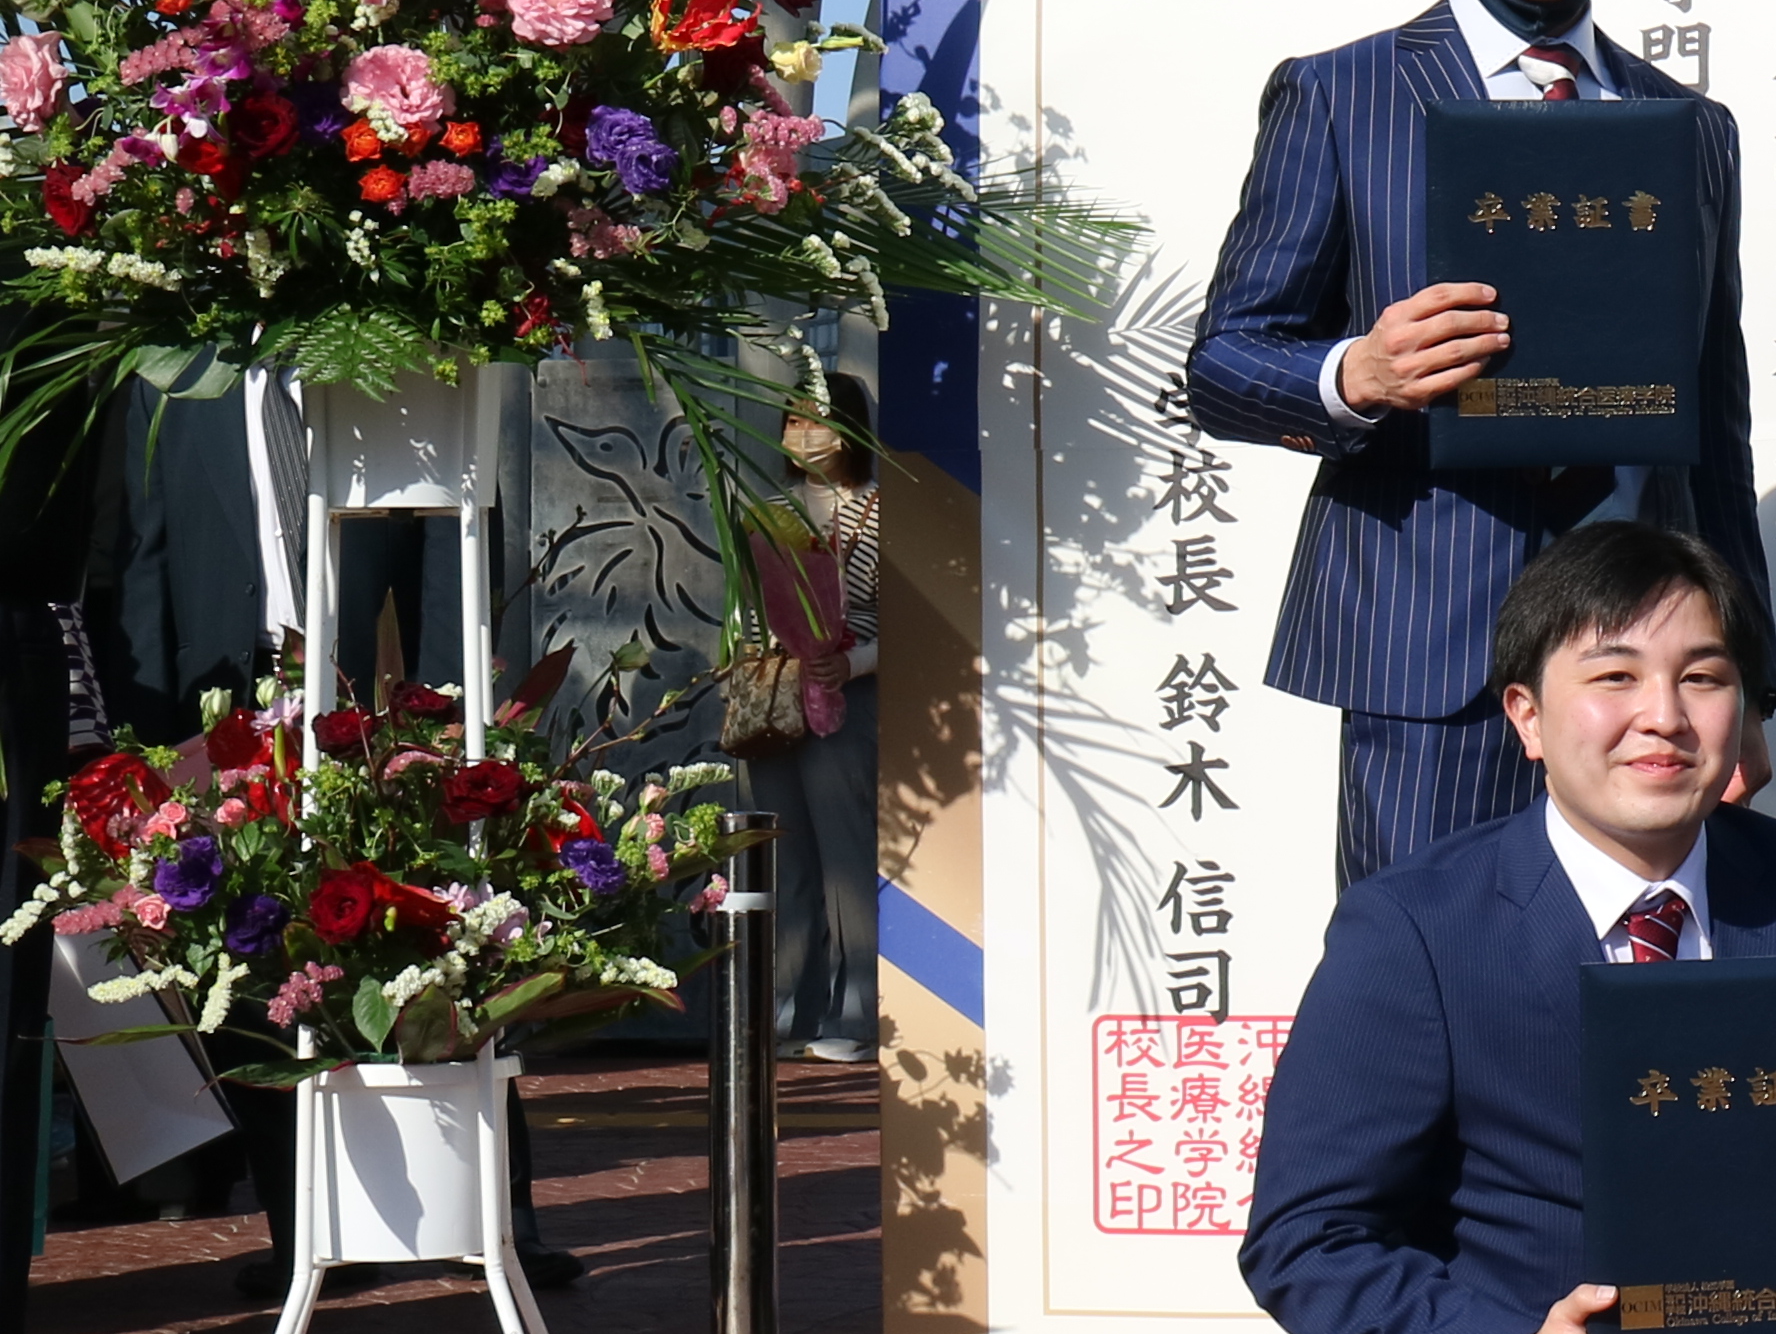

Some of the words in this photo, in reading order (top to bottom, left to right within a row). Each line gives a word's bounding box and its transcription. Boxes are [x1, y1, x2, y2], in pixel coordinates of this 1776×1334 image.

[1468, 190, 1661, 234] 卒業証書
[1157, 653, 1239, 821] 鈴木
[1157, 861, 1235, 1025] 信司
[1104, 1019, 1166, 1231] 校長之印
[1170, 1019, 1231, 1231] 医療学院
[1621, 1299, 1662, 1314] OCIM
